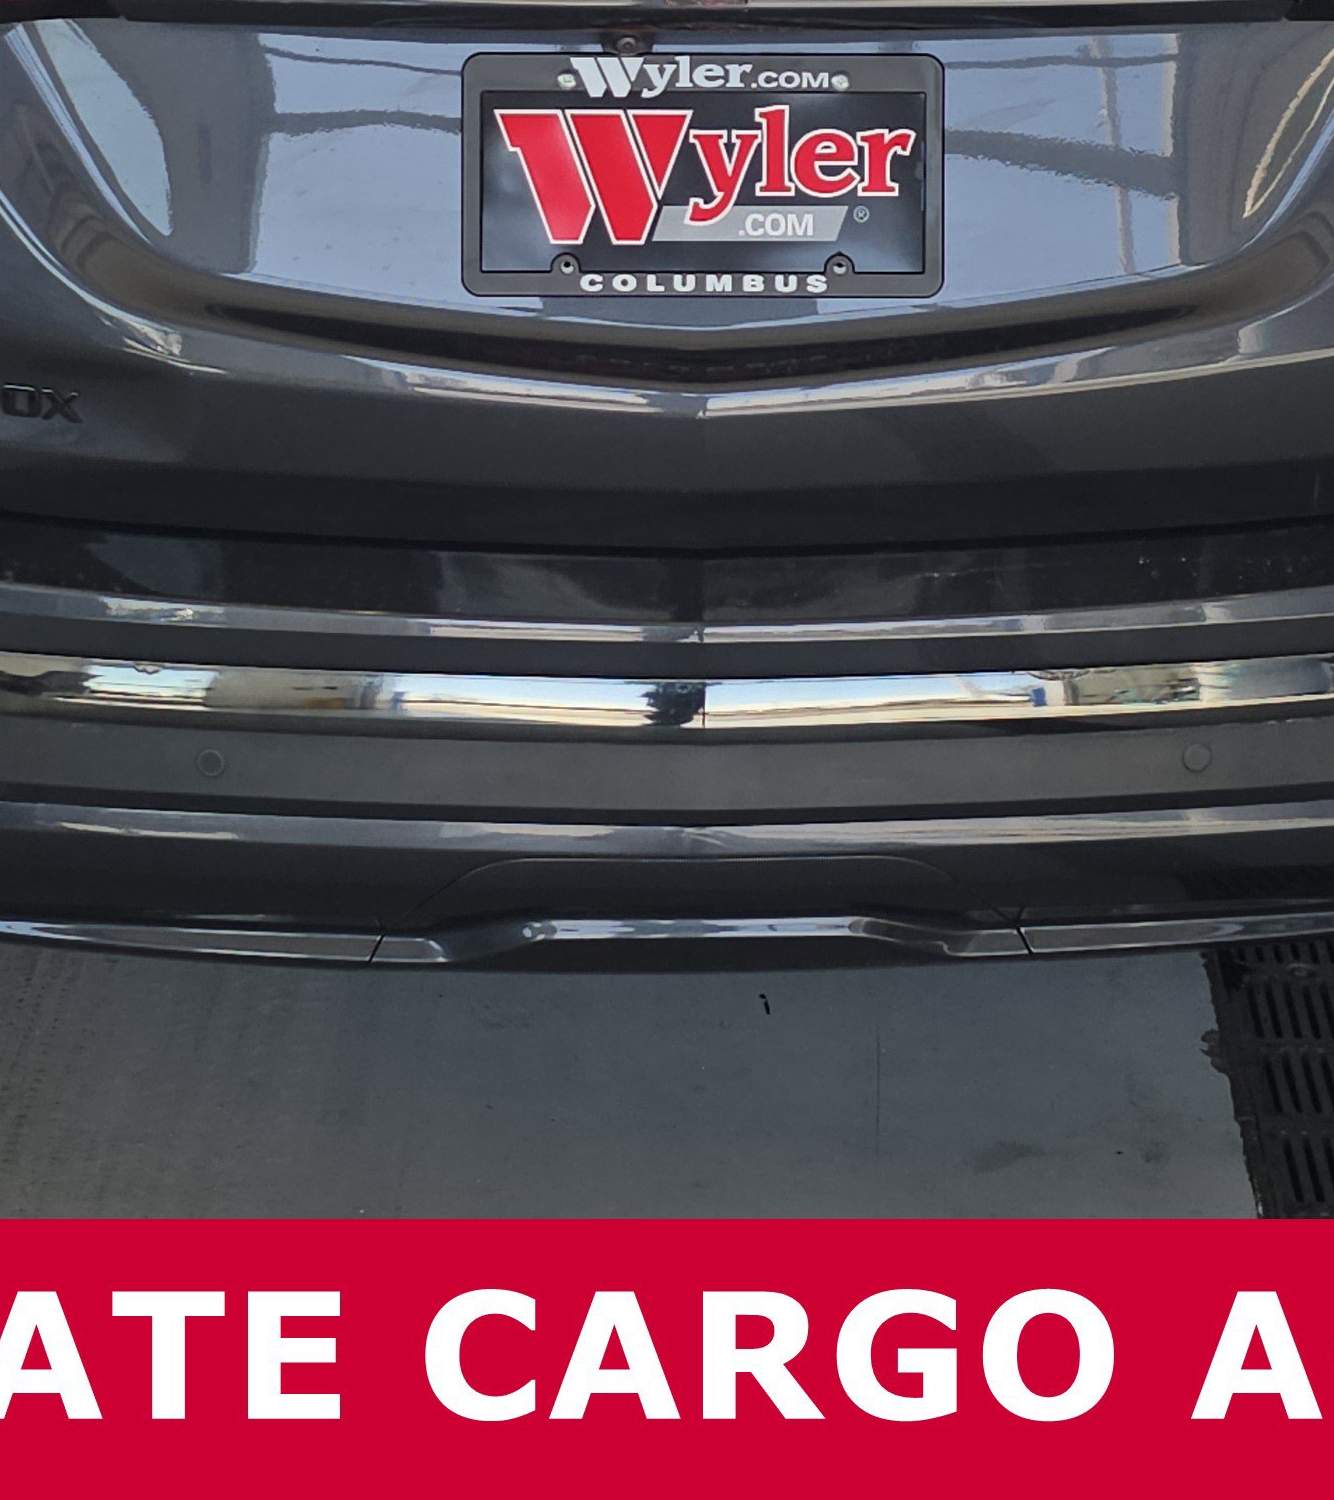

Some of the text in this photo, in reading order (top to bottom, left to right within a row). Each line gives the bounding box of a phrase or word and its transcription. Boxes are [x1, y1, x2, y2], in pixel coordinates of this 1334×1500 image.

[493, 105, 917, 245] Wyler
[738, 212, 814, 237] .COM
[579, 273, 828, 293] COLUMBUS
